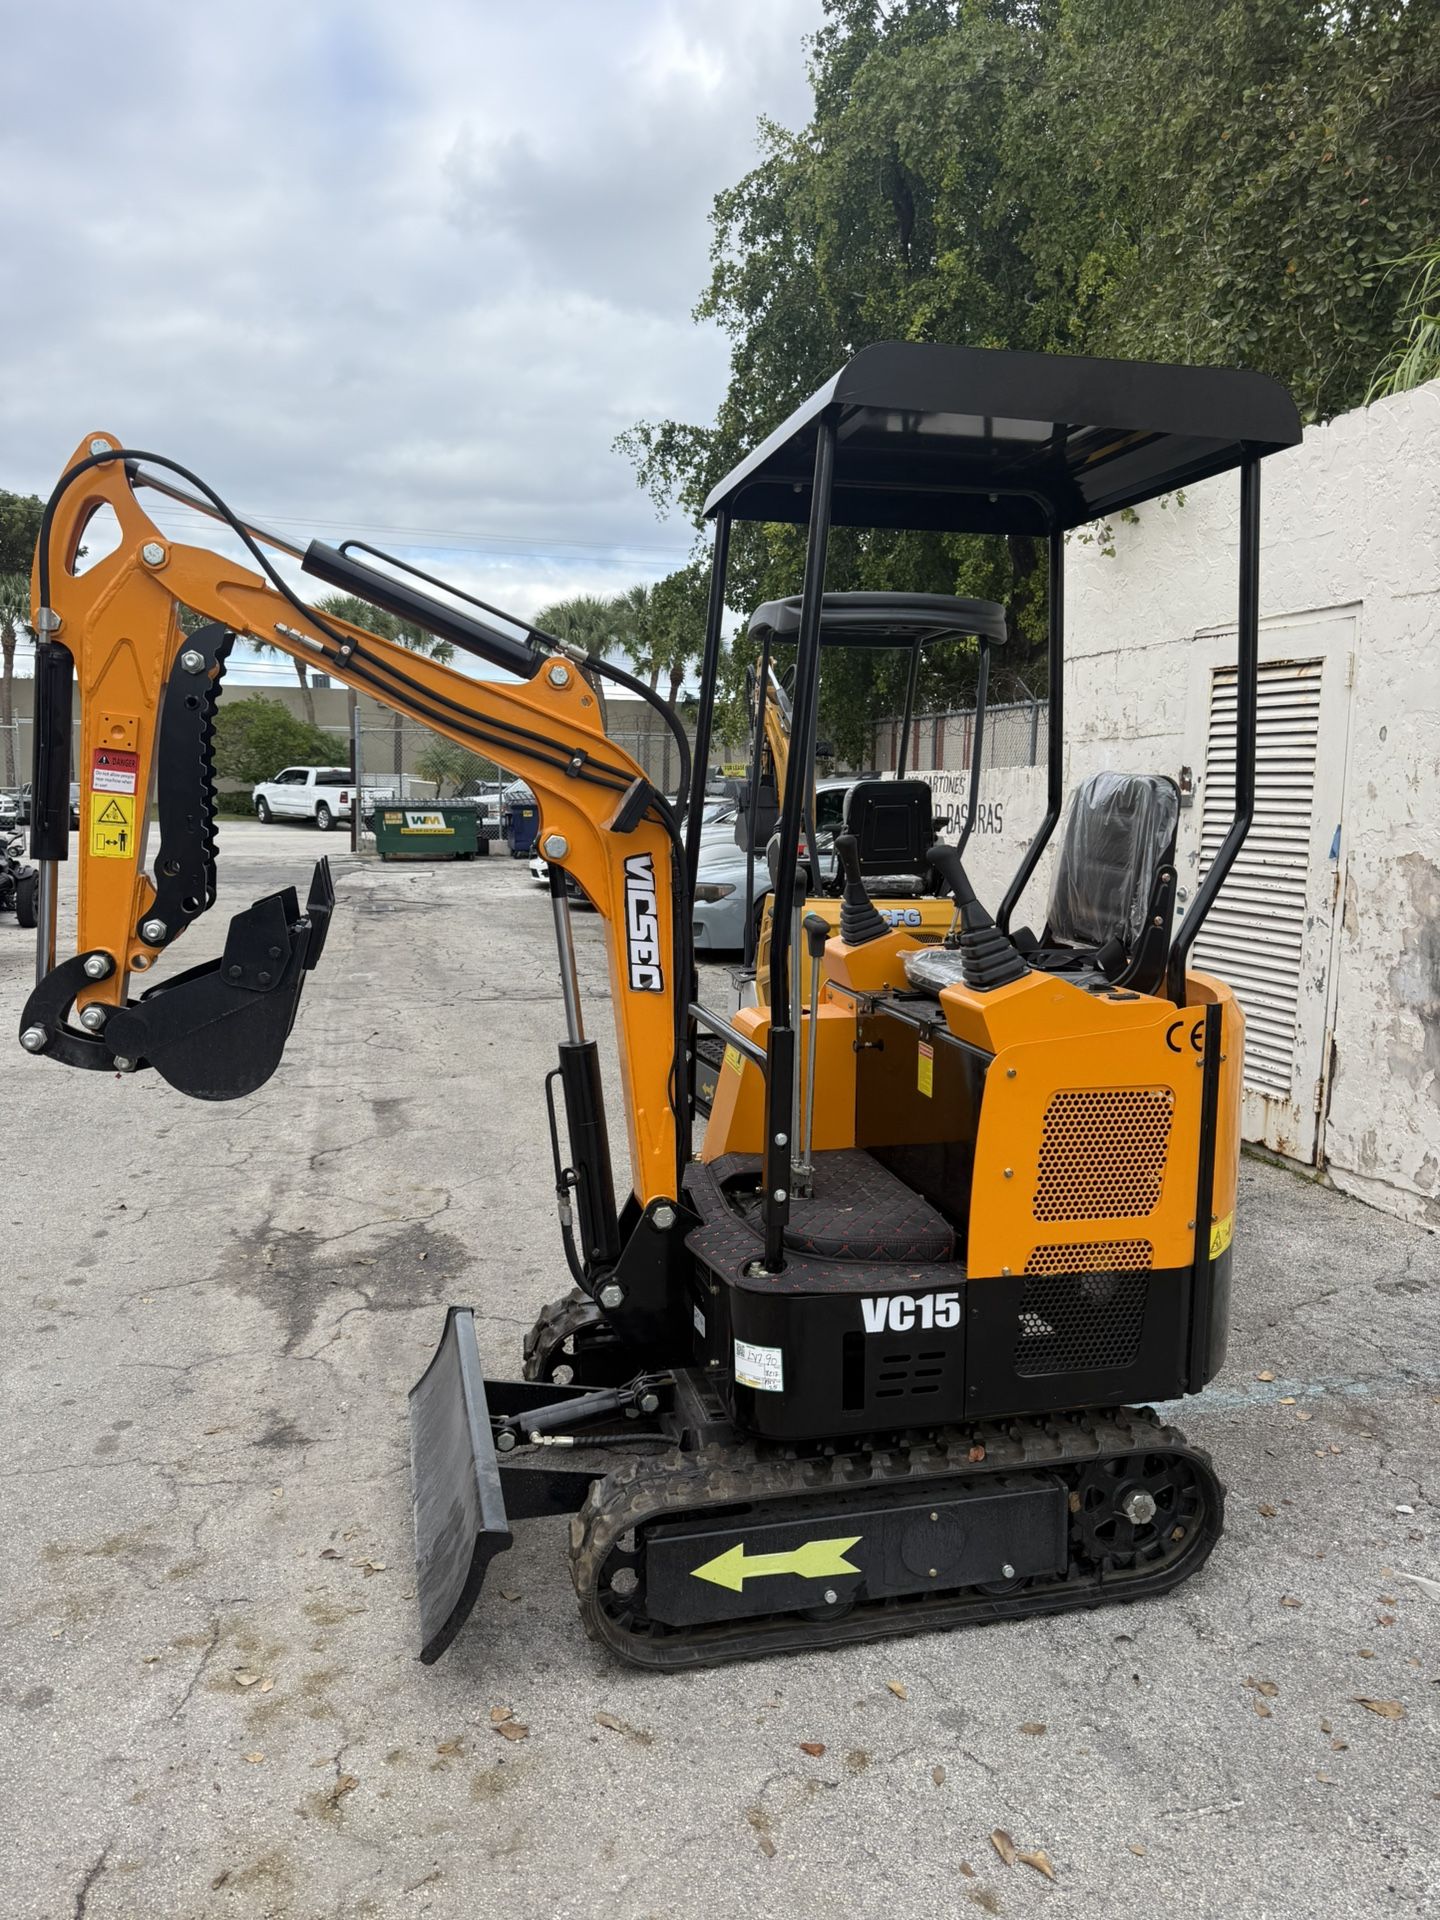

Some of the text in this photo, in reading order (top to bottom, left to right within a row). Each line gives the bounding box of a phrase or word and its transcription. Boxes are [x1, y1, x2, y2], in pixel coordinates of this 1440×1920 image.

[112, 757, 136, 767] DANGER
[411, 816, 440, 825] WM
[625, 853, 662, 990] VICSEC
[1166, 1020, 1205, 1053] CE
[860, 1292, 961, 1334] VC15
